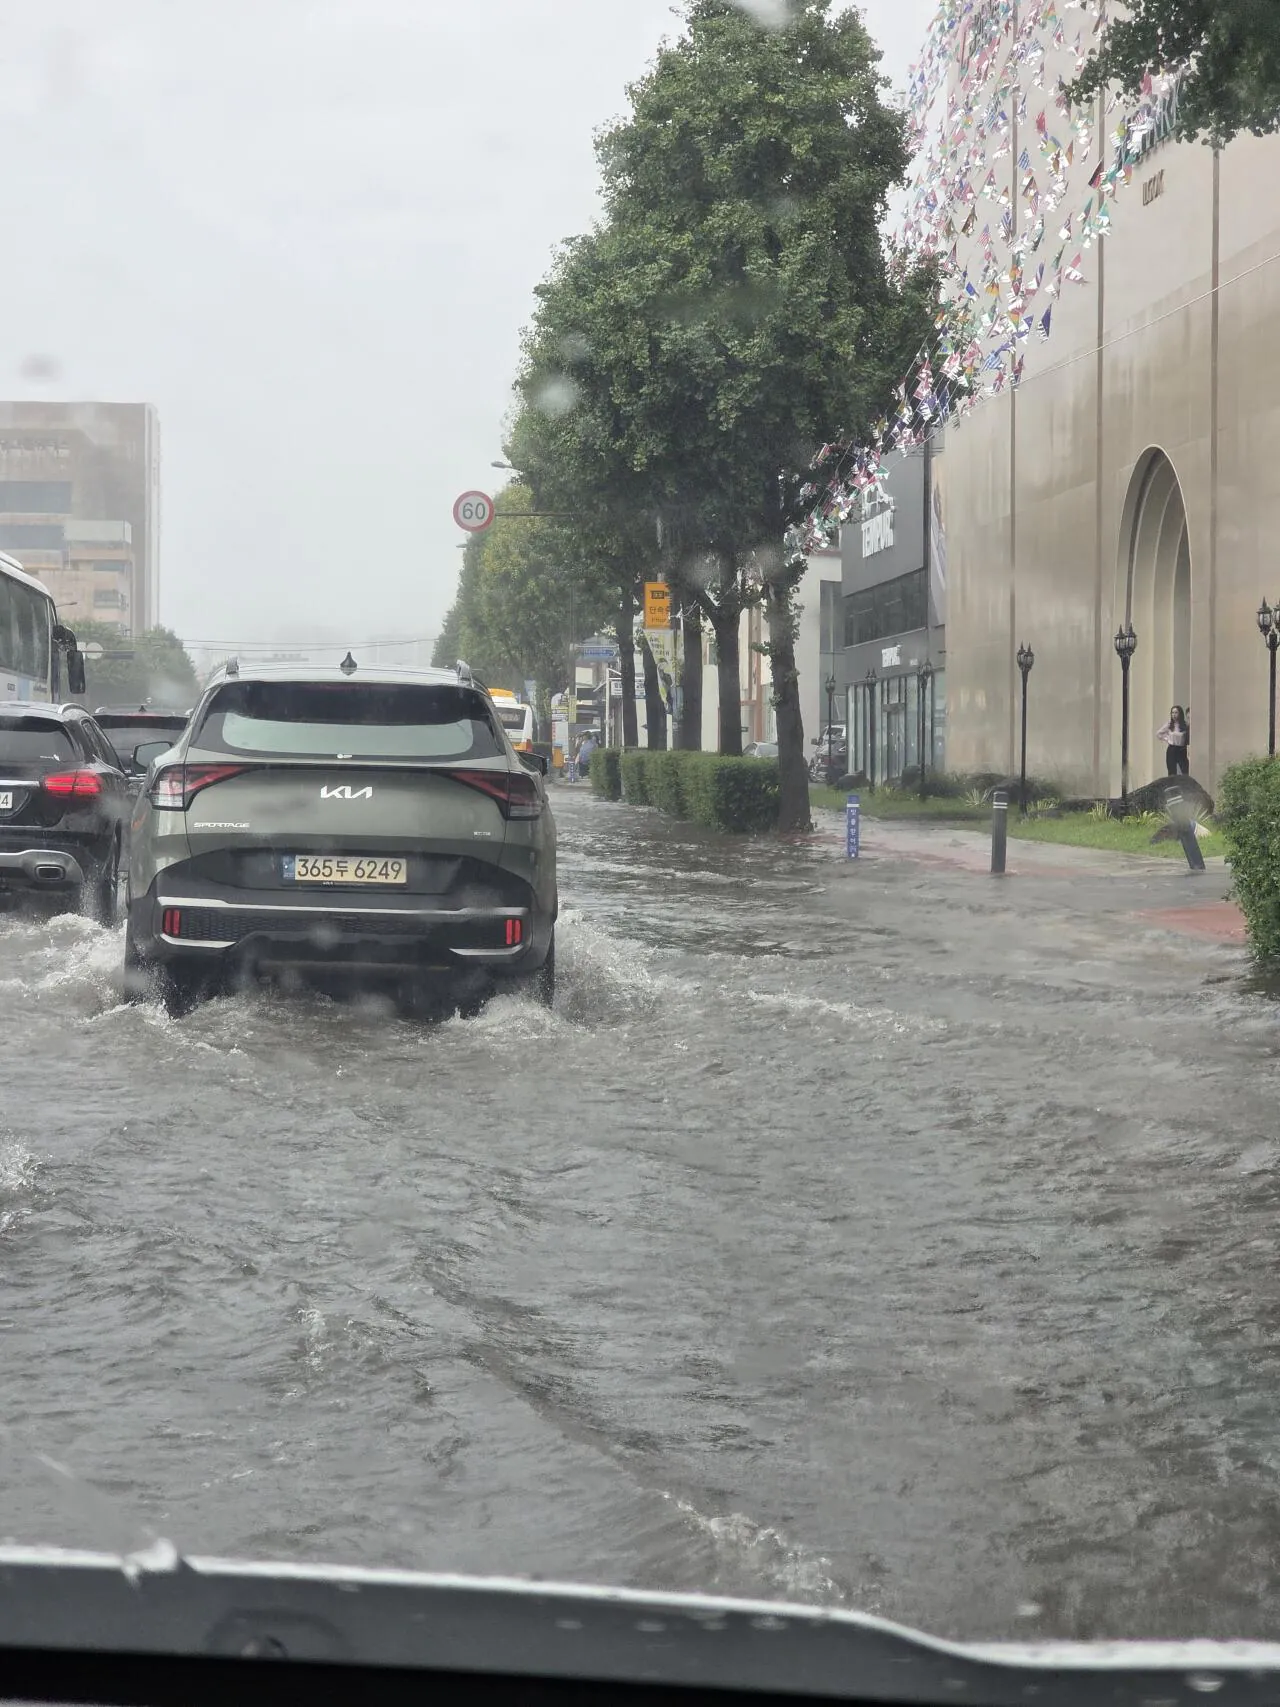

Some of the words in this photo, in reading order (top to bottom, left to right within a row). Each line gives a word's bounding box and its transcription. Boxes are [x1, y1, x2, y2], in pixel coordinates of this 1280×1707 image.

[462, 502, 486, 520] 60
[861, 508, 895, 559] TEMPUR
[320, 785, 373, 799] KIA
[193, 821, 250, 829] SPORTAGE
[354, 859, 402, 879] 6249
